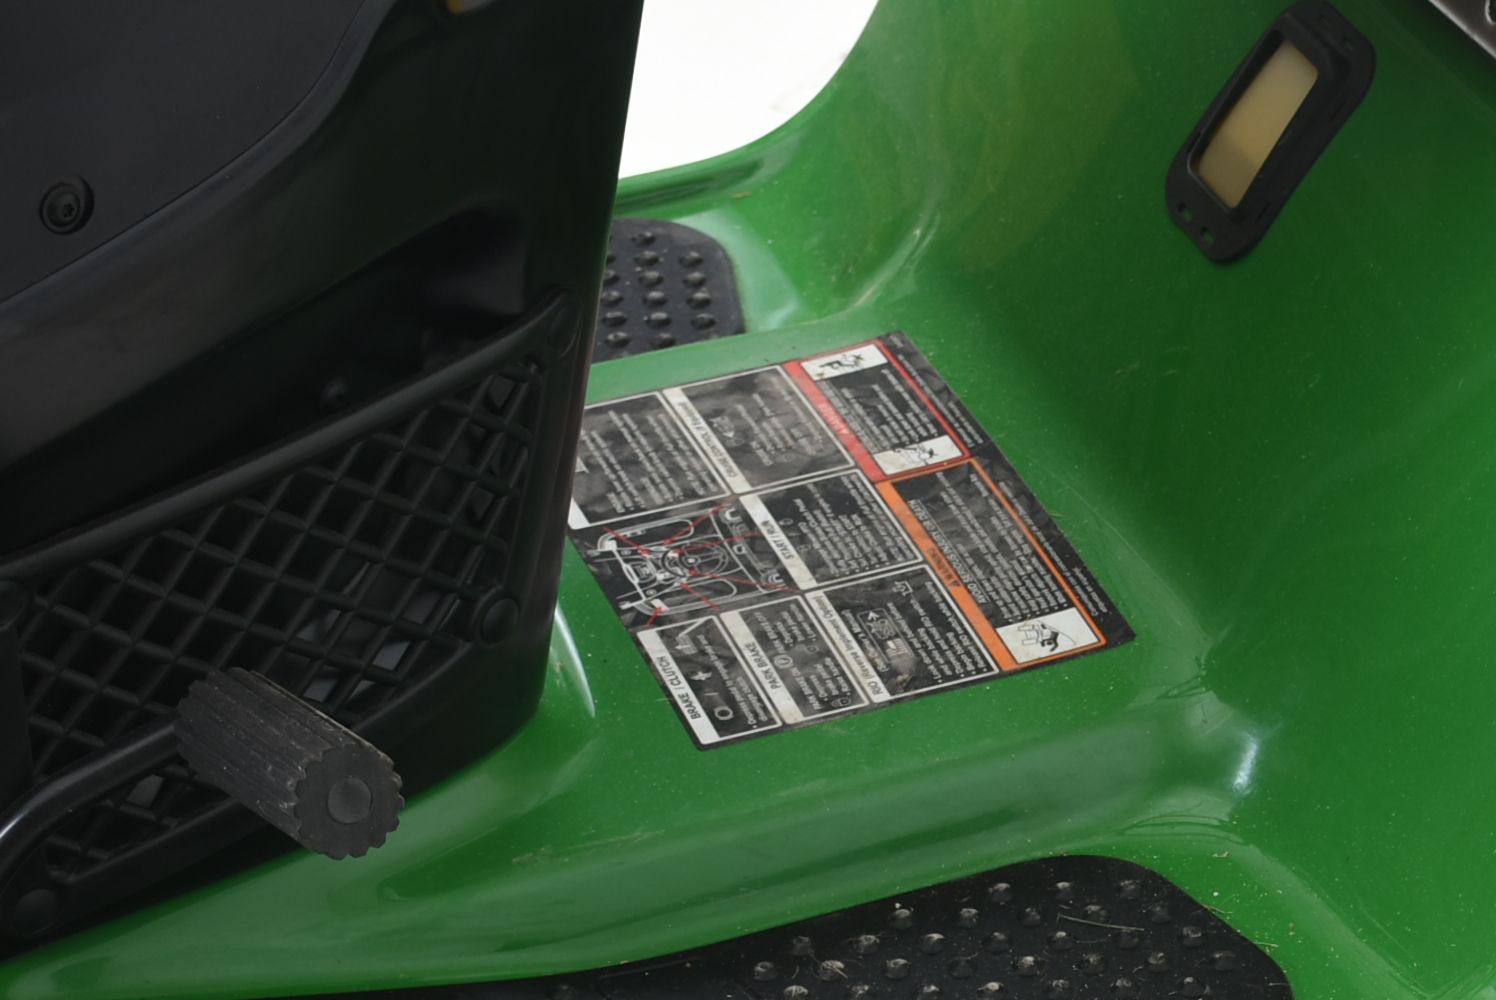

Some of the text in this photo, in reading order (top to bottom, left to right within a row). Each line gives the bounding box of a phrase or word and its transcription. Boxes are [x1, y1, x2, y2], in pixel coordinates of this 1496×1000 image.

[760, 519, 777, 534] RUN
[772, 538, 794, 559] START
[655, 655, 681, 686] CLUTCH
[743, 641, 782, 689] PARK BRAKE
[676, 691, 701, 720] BRAKE
